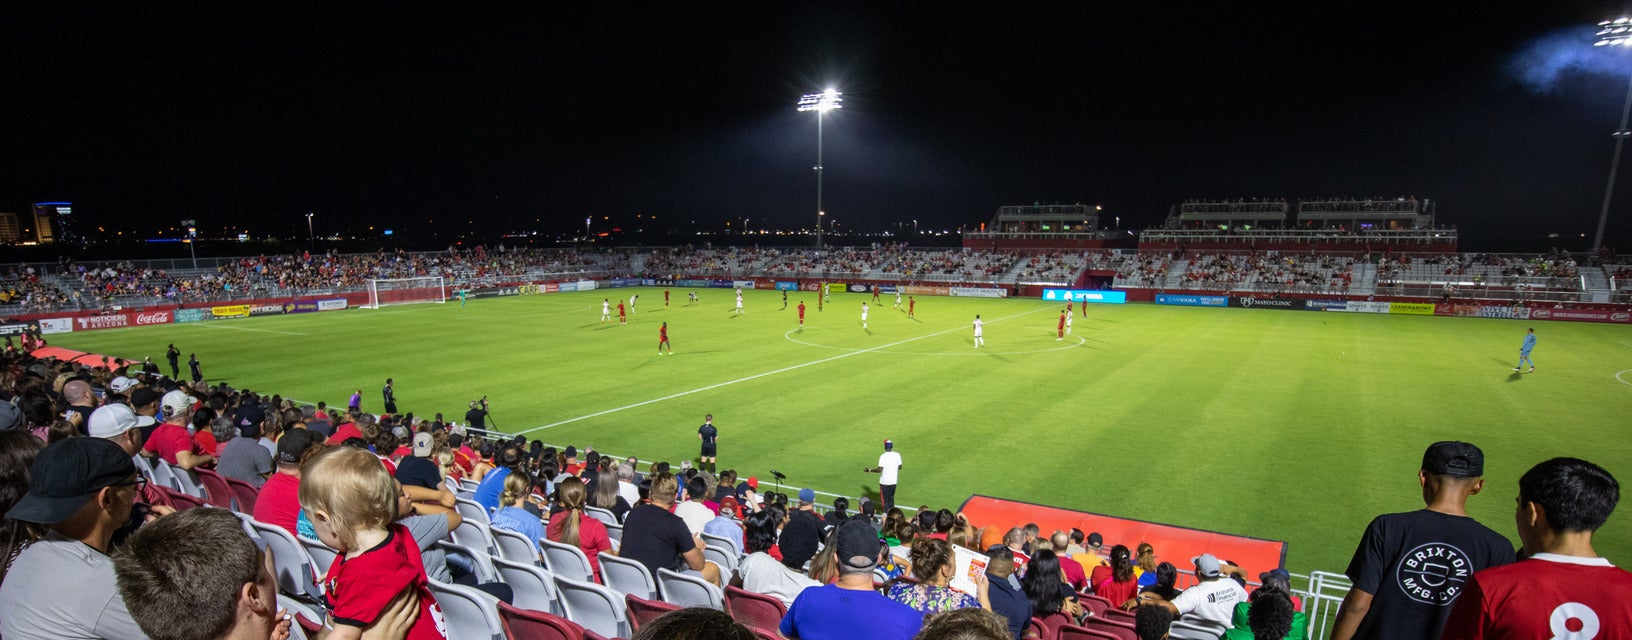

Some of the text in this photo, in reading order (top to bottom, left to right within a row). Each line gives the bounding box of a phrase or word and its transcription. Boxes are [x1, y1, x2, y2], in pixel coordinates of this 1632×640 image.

[1167, 296, 1197, 304] CARVANA
[90, 314, 127, 323] NOTICIERO
[91, 321, 128, 329] ARIZONA
[1406, 547, 1468, 576] BRIXTON
[1215, 587, 1234, 597] Arizona
[1403, 577, 1459, 601] MFG. CO.
